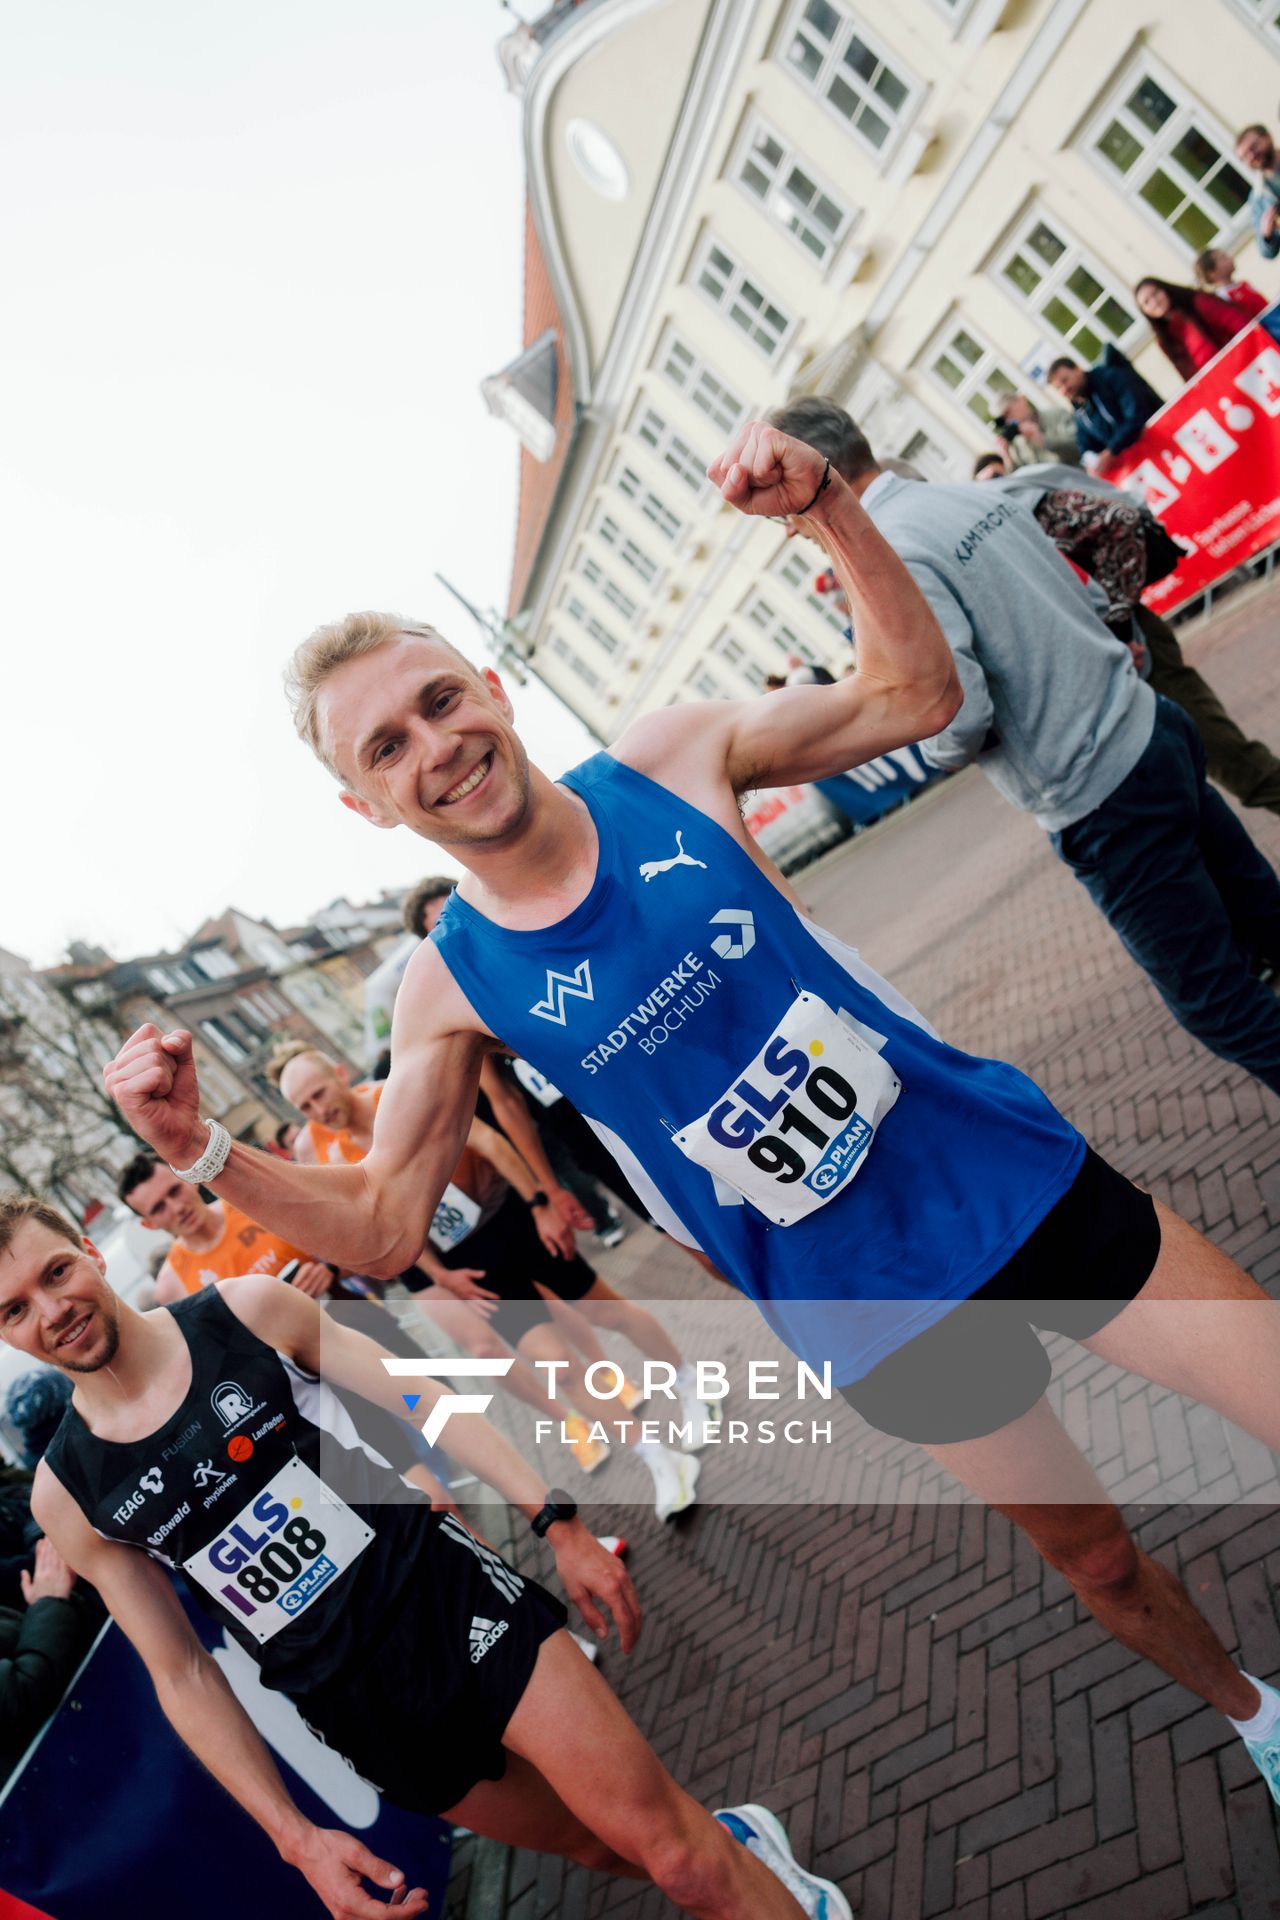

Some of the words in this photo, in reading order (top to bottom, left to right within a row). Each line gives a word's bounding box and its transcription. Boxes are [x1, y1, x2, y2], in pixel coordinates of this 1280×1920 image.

[581, 952, 703, 1075] STADTWERKE
[638, 969, 722, 1055] BOCHUM
[748, 1066, 857, 1183] 910
[830, 1119, 867, 1166] PLAN
[843, 1130, 872, 1170] INTERNATIONAL
[161, 1421, 202, 1461] FUSION
[251, 1412, 285, 1442] Laufladen
[112, 1490, 146, 1526] TEAG
[203, 1474, 238, 1509] physio4me
[236, 1516, 327, 1604] 808
[299, 1559, 332, 1593] PLAN
[470, 1620, 509, 1664] adidas
